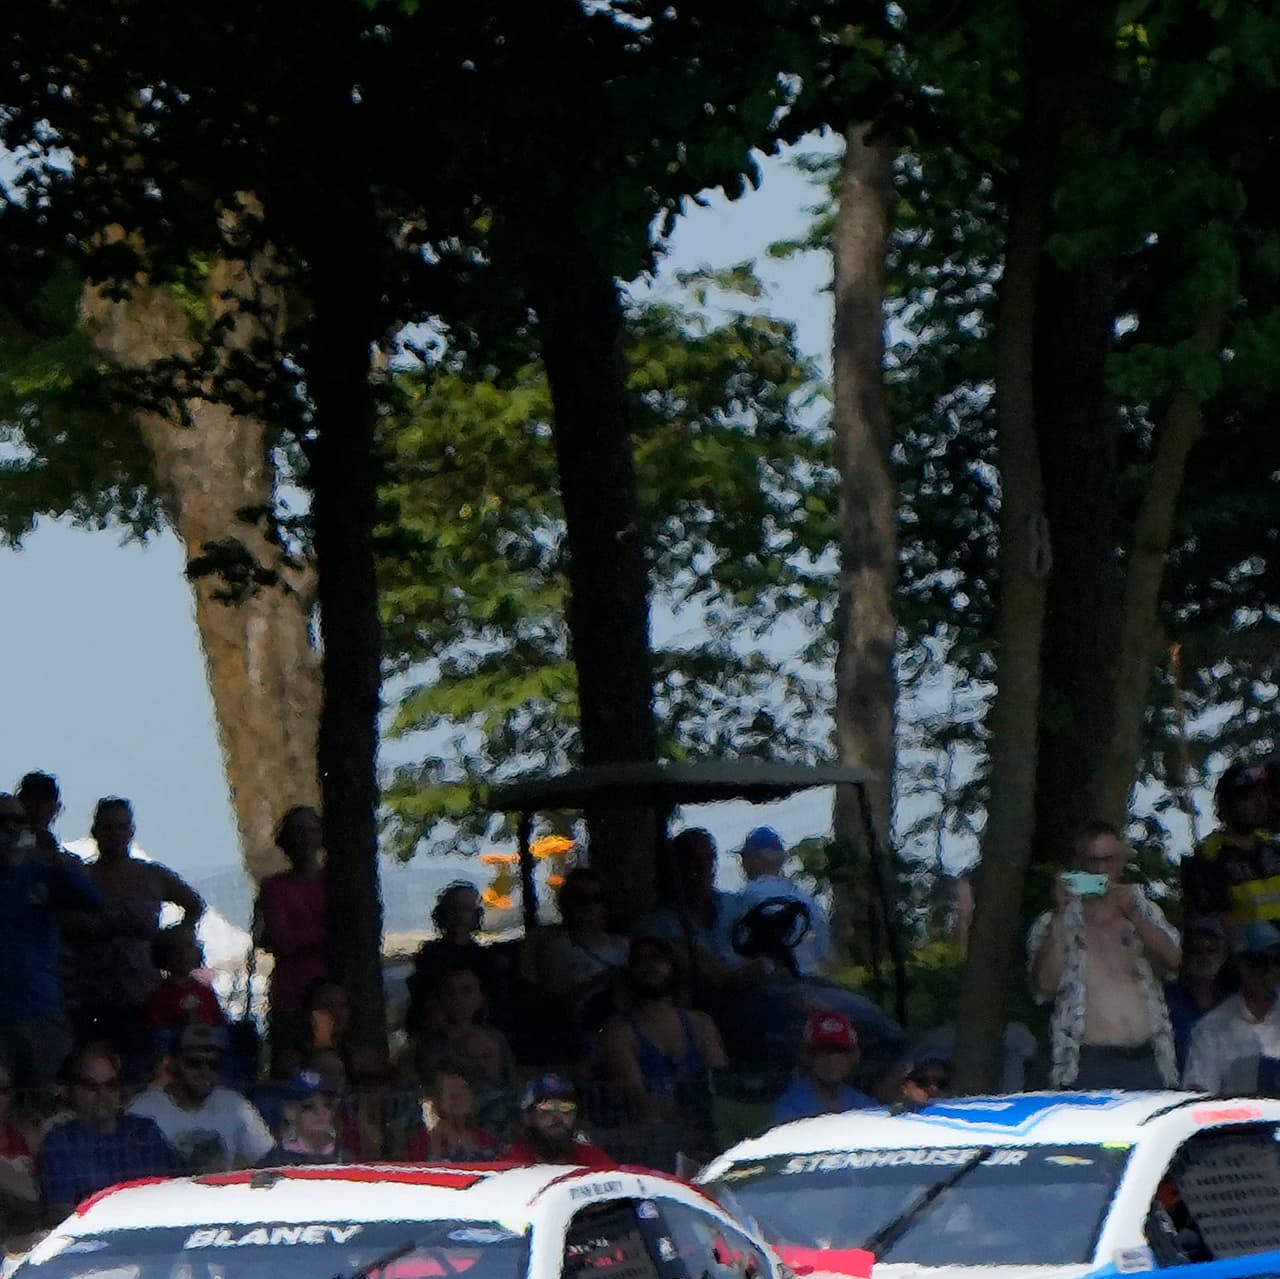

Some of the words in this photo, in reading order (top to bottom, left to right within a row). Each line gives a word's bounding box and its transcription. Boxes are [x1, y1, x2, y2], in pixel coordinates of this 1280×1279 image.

[780, 1149, 983, 1175] STENHOUSE
[981, 1149, 1028, 1165] JR
[183, 1224, 364, 1250] BLANEY
